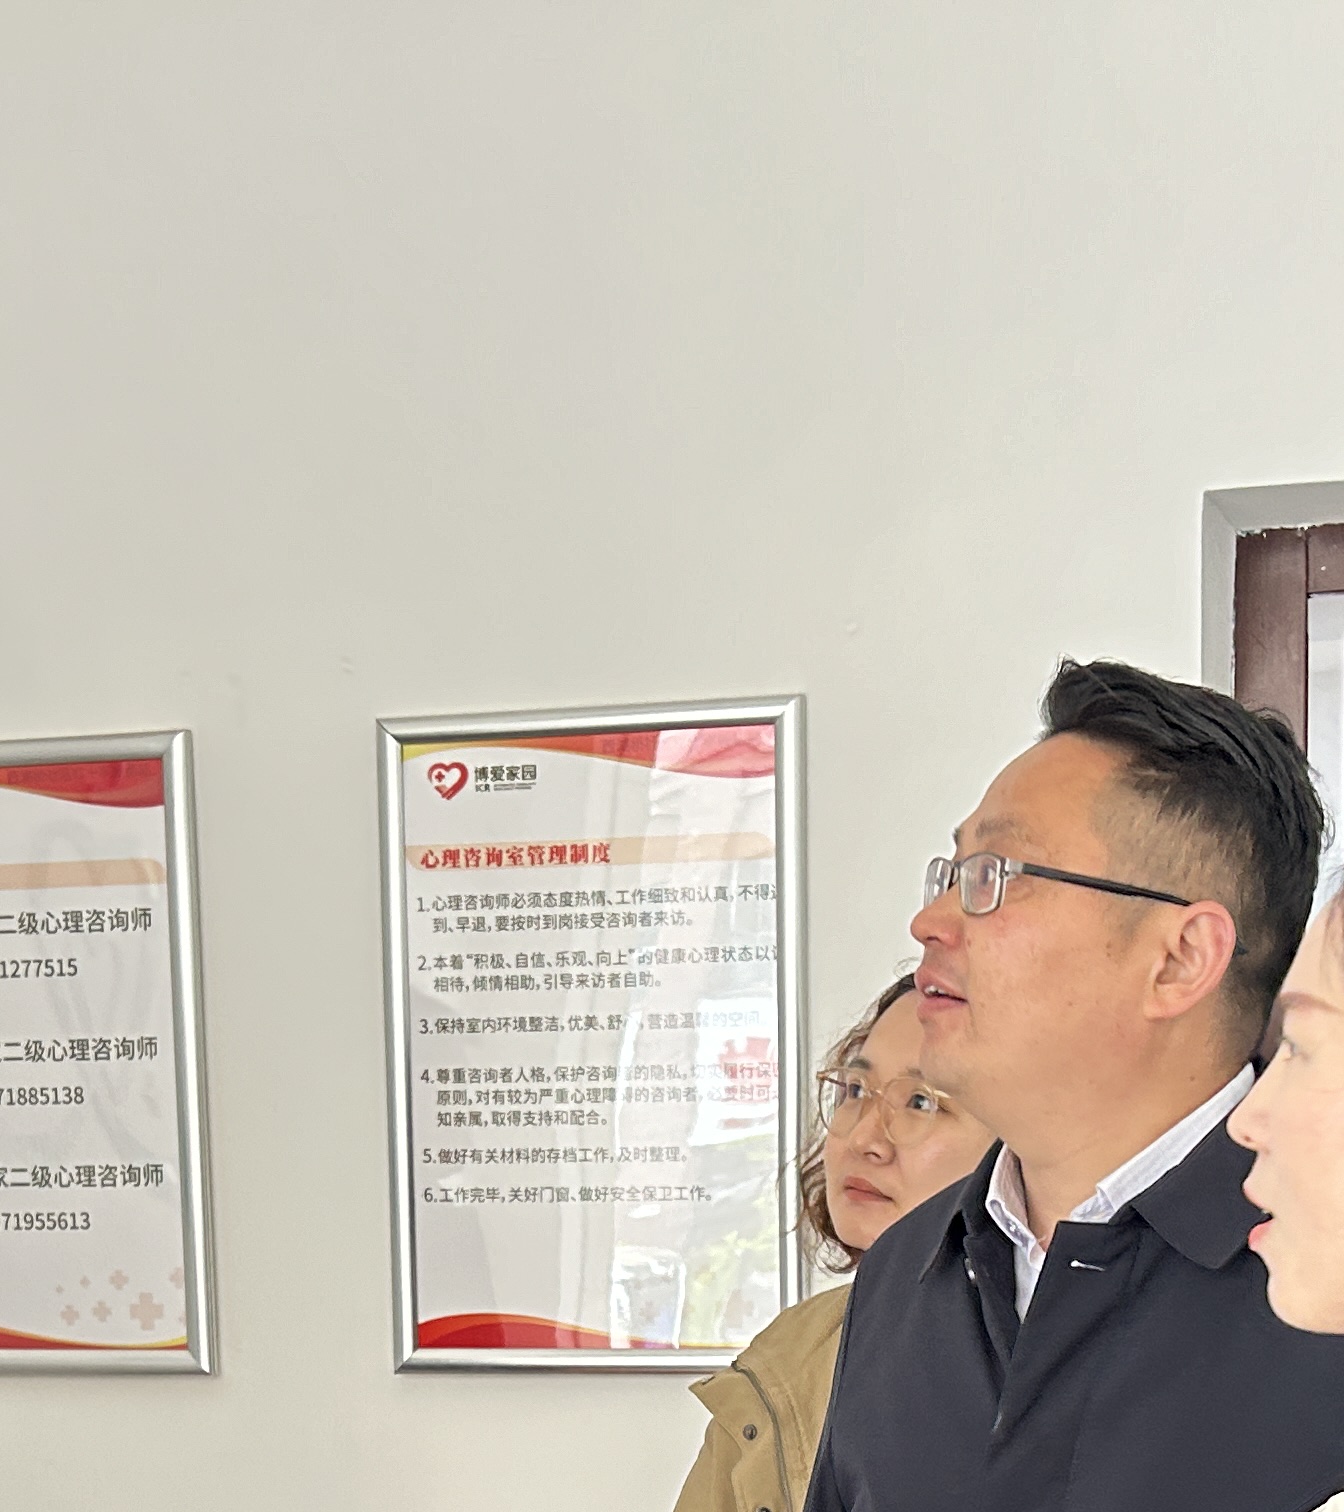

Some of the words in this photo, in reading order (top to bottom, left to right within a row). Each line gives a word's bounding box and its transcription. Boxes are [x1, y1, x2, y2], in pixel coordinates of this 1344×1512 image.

[420, 842, 612, 869] 心理咨询室管理制度
